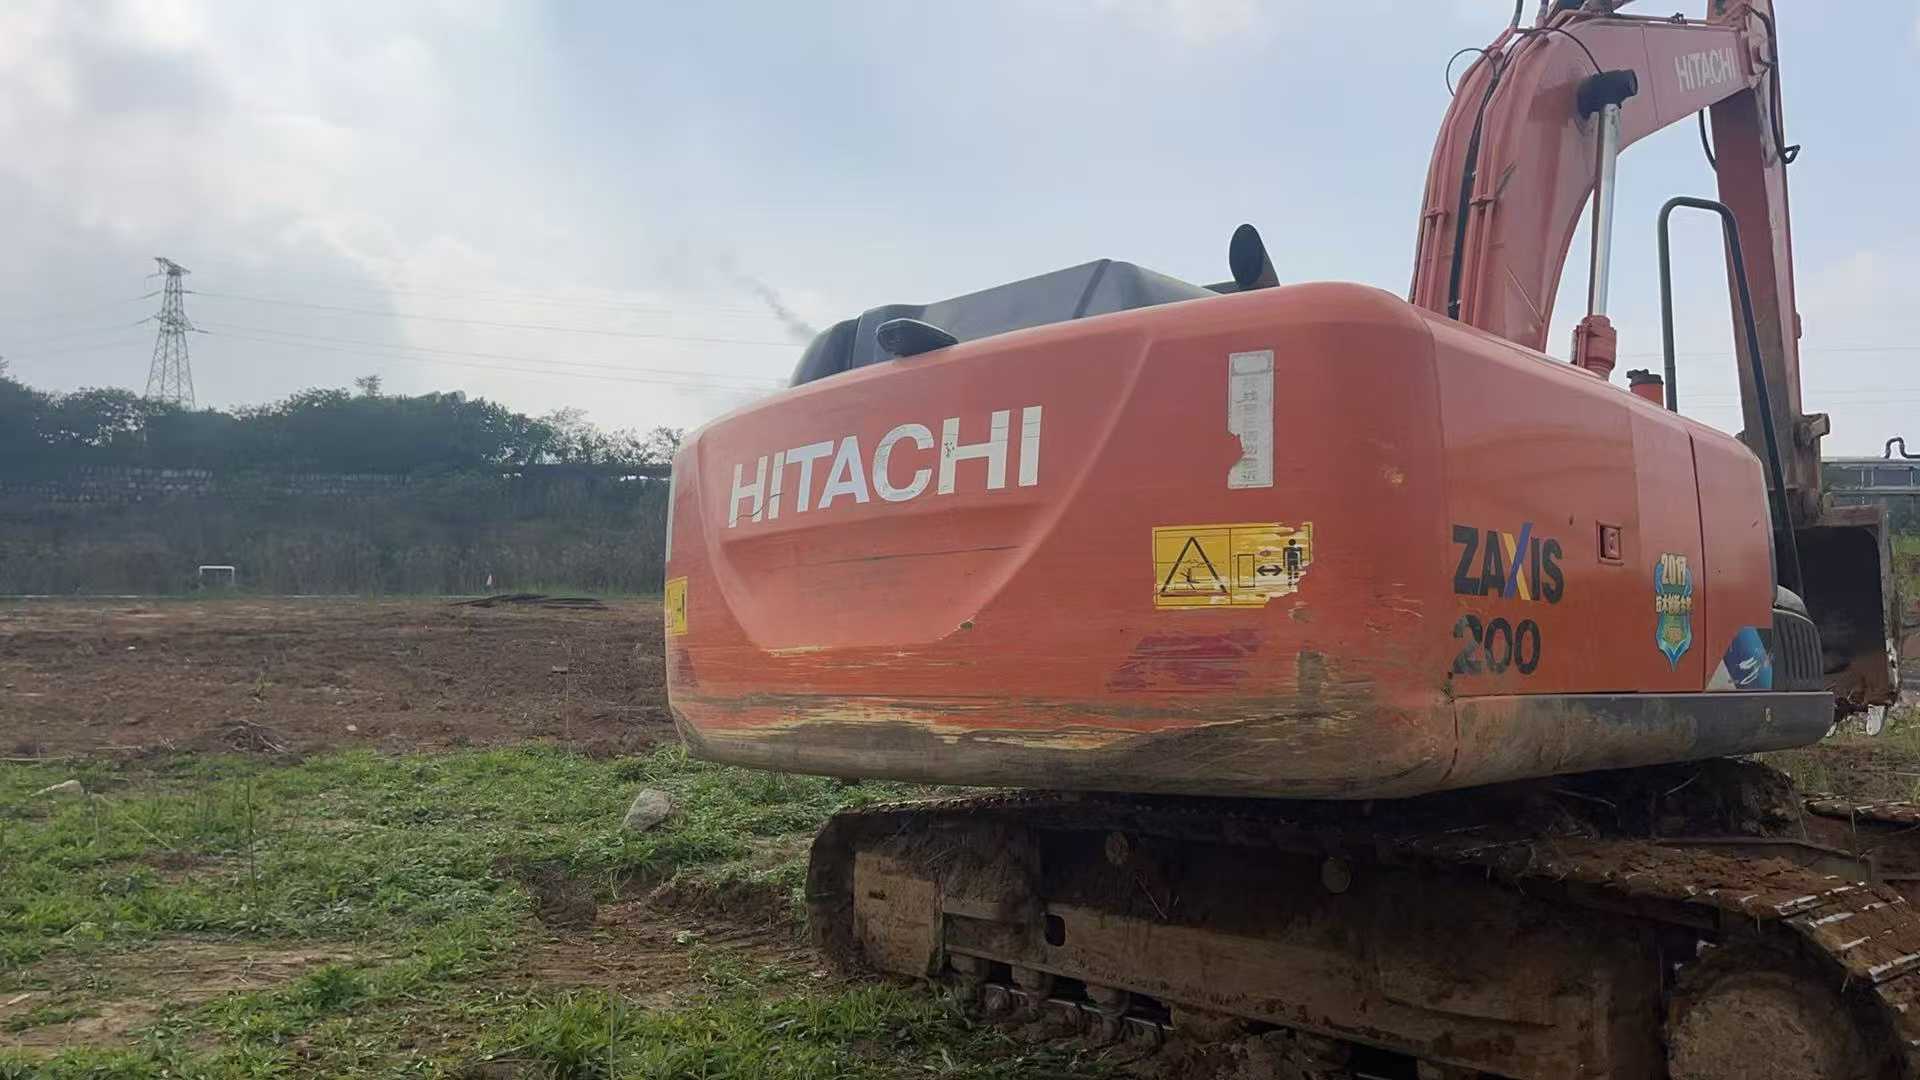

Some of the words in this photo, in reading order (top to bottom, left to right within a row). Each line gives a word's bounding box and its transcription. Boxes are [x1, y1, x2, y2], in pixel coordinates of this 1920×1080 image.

[1674, 47, 1736, 93] HITACHI
[728, 406, 1042, 528] HITACHI
[1453, 522, 1564, 604] ZAXIS
[1453, 614, 1541, 675] 200
